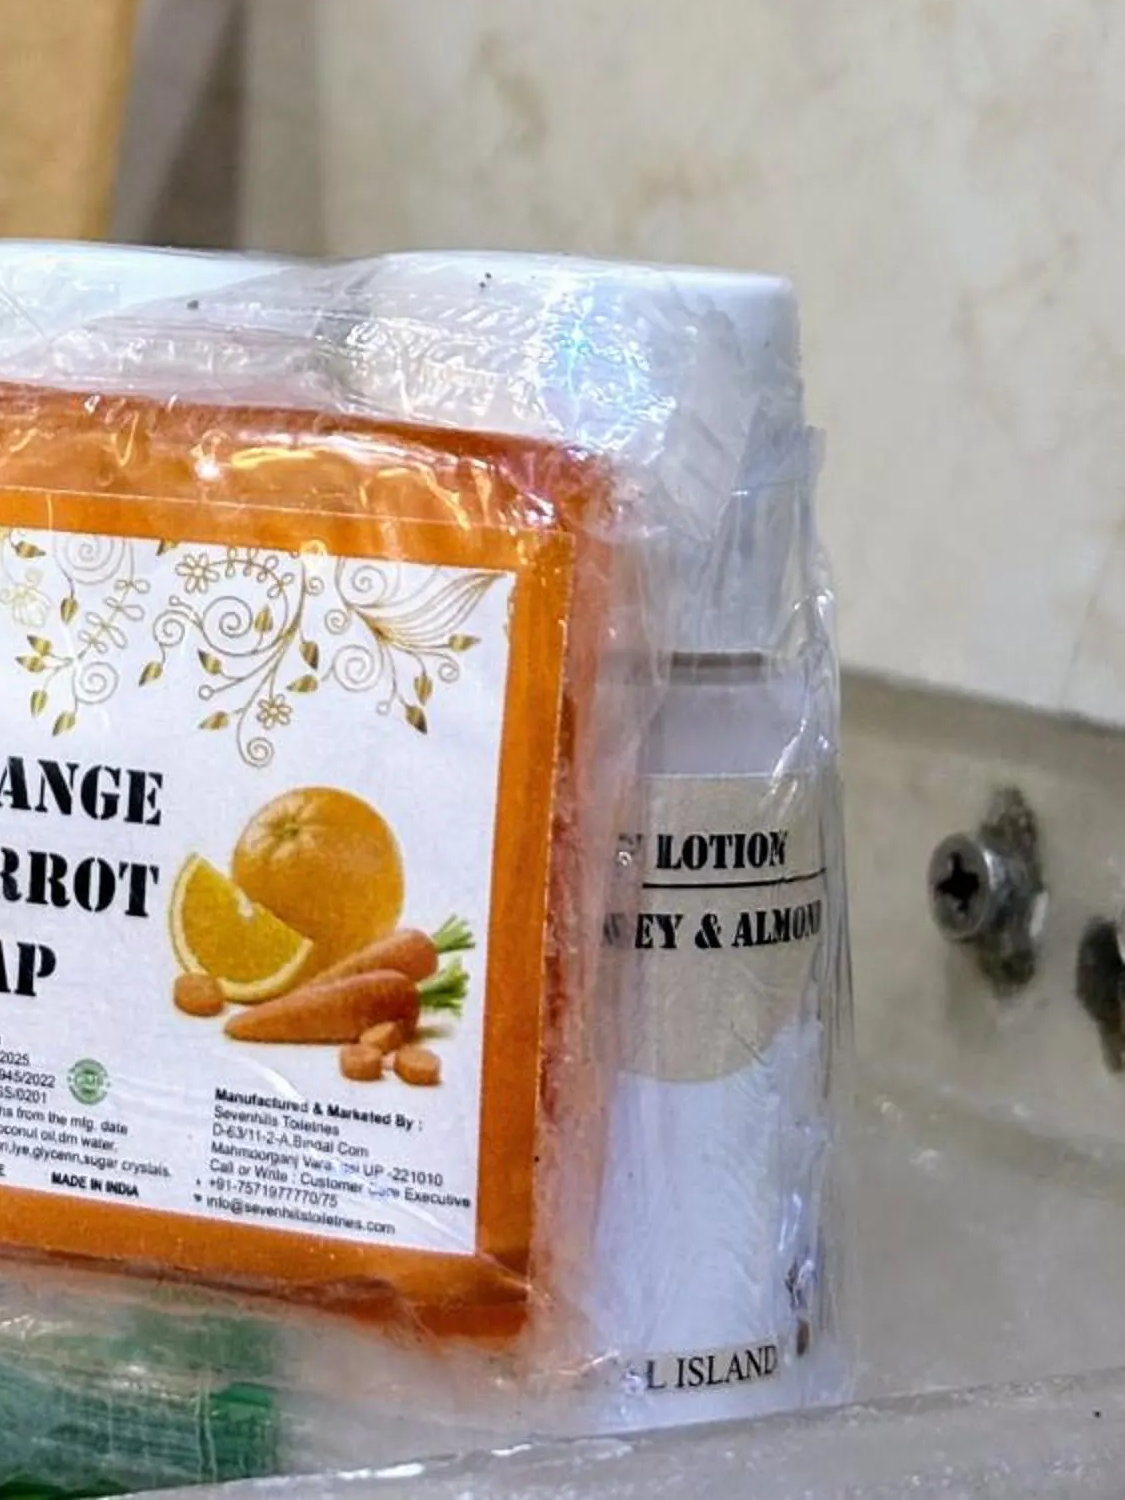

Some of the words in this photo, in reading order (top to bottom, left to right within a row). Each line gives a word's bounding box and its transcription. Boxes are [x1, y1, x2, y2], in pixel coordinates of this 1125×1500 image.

[656, 830, 789, 870] LOTION
[694, 913, 723, 949] &
[17, 1106, 46, 1121] from
[48, 1111, 67, 1126] the
[100, 1120, 128, 1136] date
[214, 1104, 279, 1128] Sevenhills
[282, 1115, 340, 1137] Toiletries
[215, 1087, 310, 1114] Manufactured
[313, 1101, 323, 1116] &
[327, 1103, 392, 1126] Marketed
[395, 1113, 414, 1132] By
[51, 1171, 89, 1189] MADE
[91, 1177, 103, 1193] IN
[105, 1181, 140, 1198] INDIA
[210, 1157, 234, 1174] Call
[238, 1164, 252, 1177] or
[254, 1164, 288, 1182] Write
[300, 1171, 364, 1194] Customer
[404, 1187, 471, 1208] Executive
[362, 1163, 384, 1177] UP
[676, 1345, 778, 1388] ISLAND
